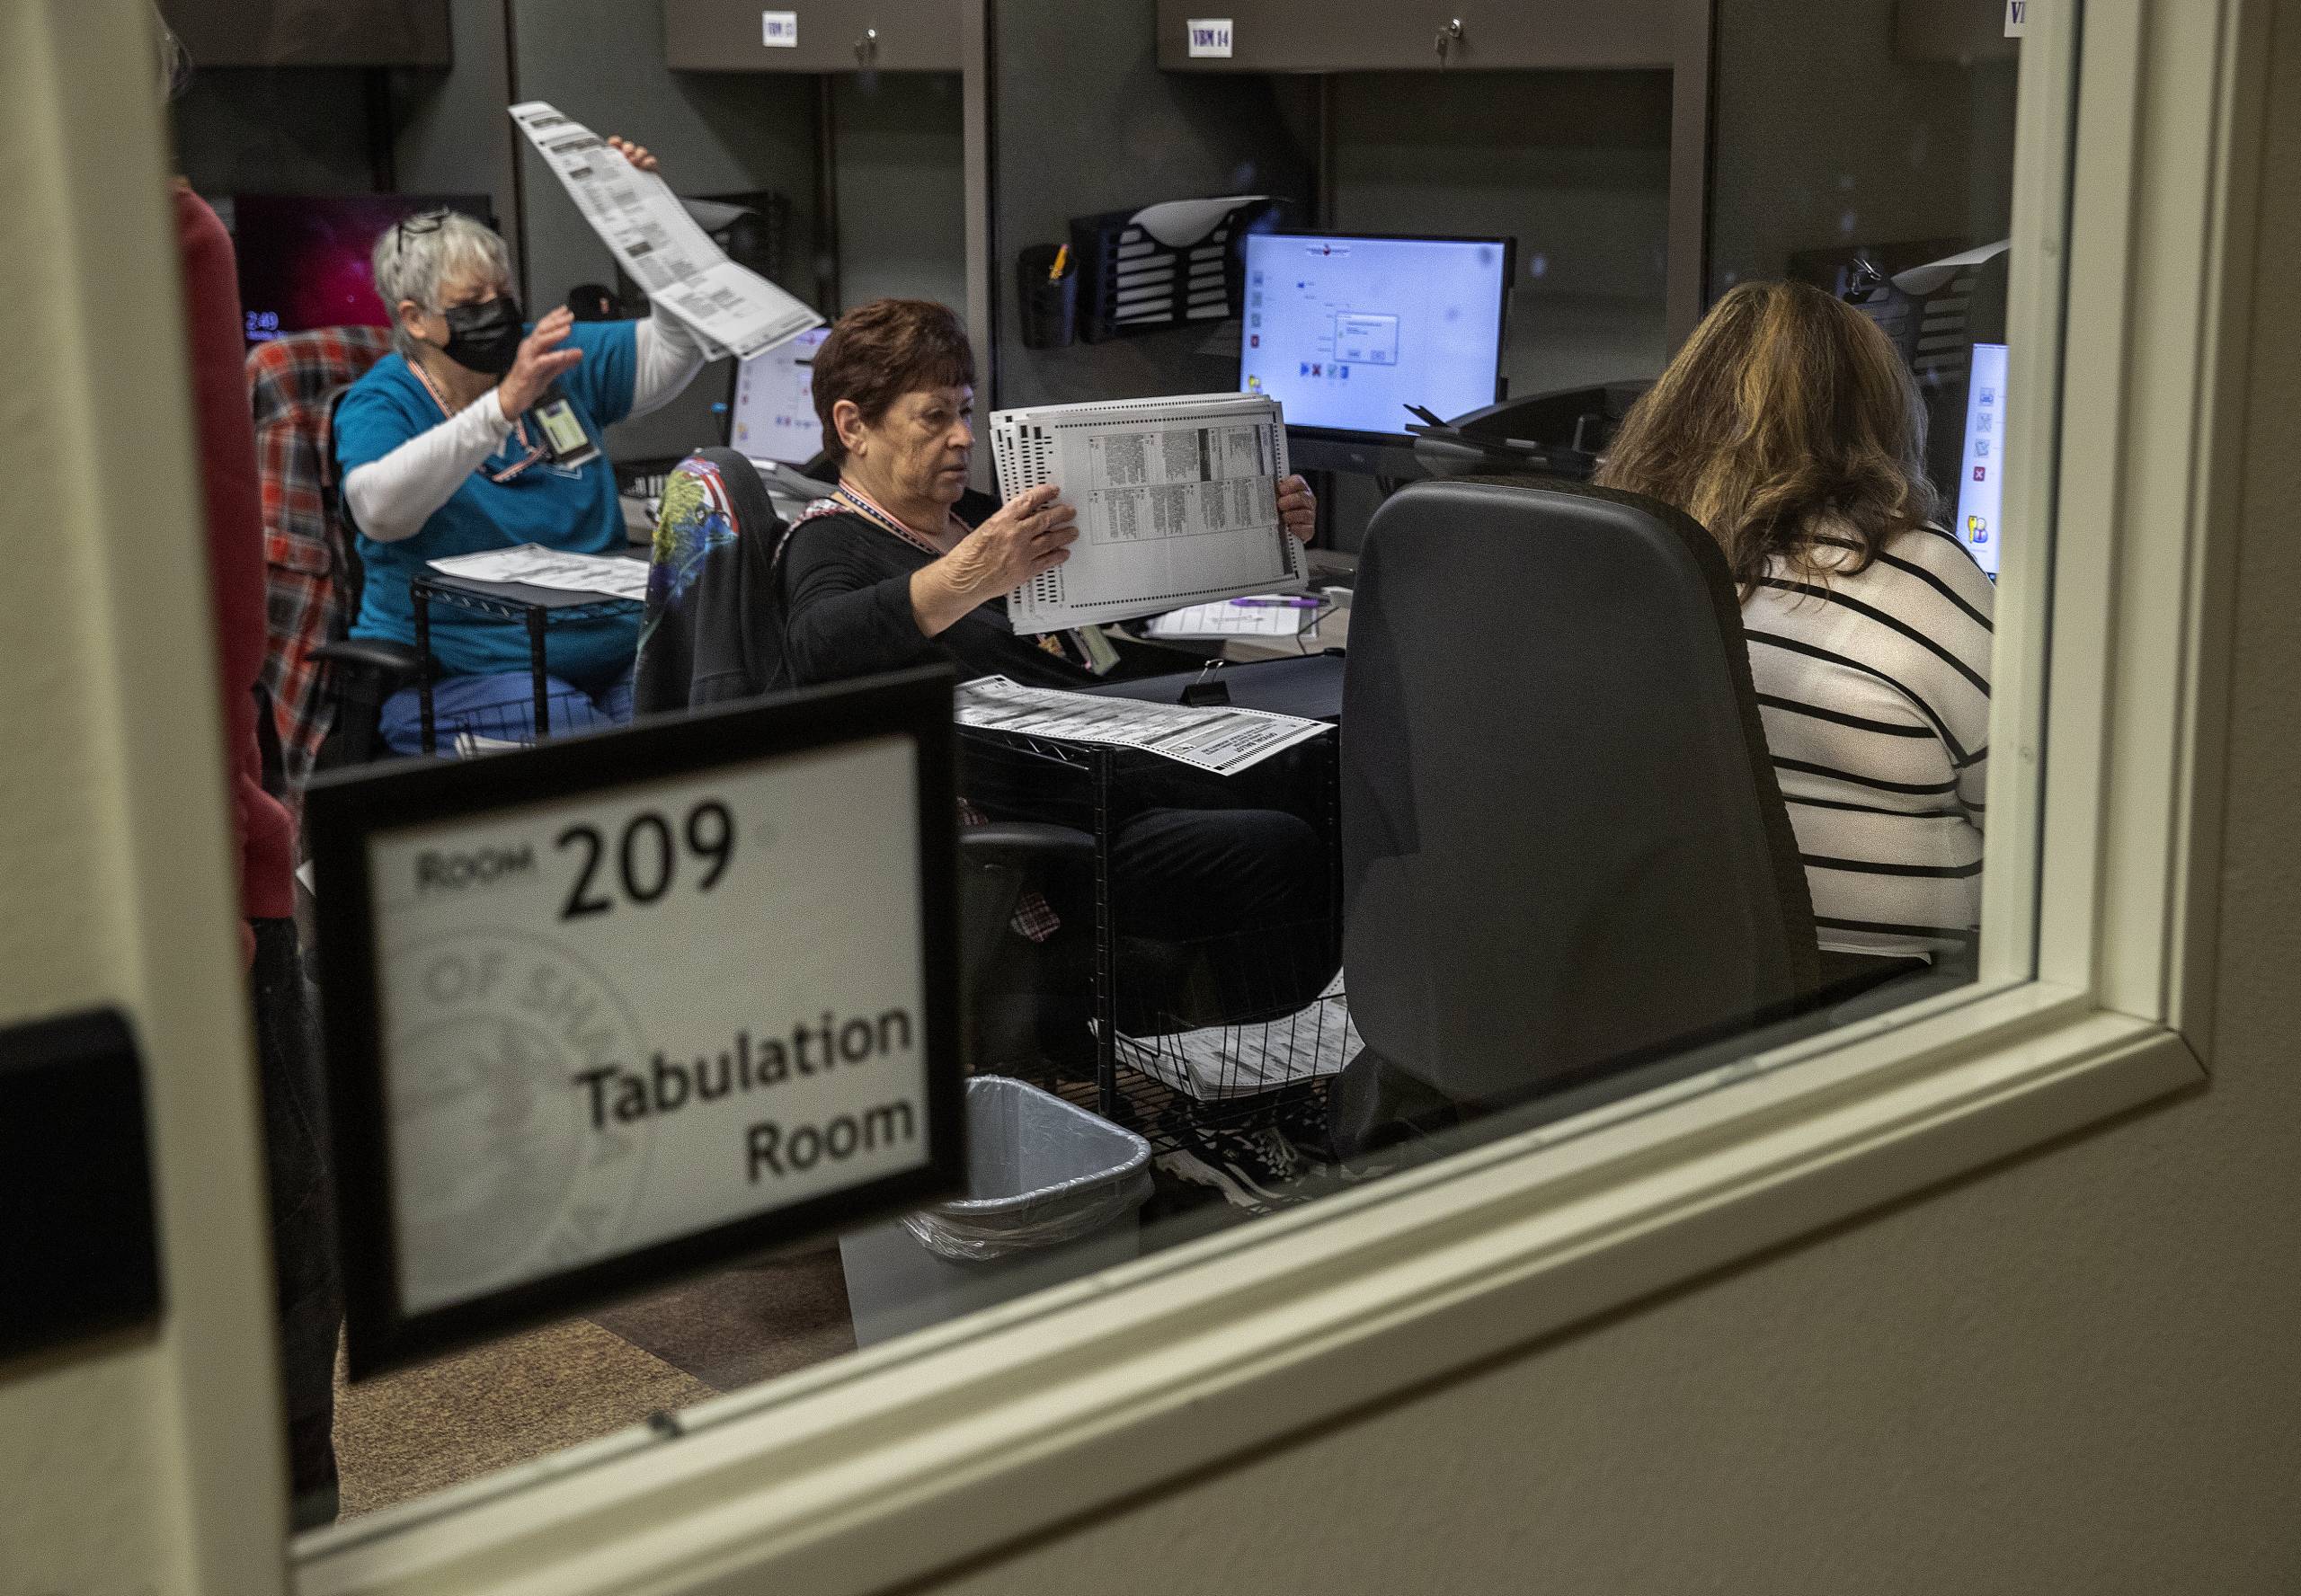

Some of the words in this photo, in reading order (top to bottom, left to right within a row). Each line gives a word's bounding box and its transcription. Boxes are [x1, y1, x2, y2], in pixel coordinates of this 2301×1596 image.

[1217, 30, 1229, 47] 14
[555, 798, 738, 922] 209
[575, 1006, 913, 1131] Tabulation
[746, 1098, 914, 1184] Room
